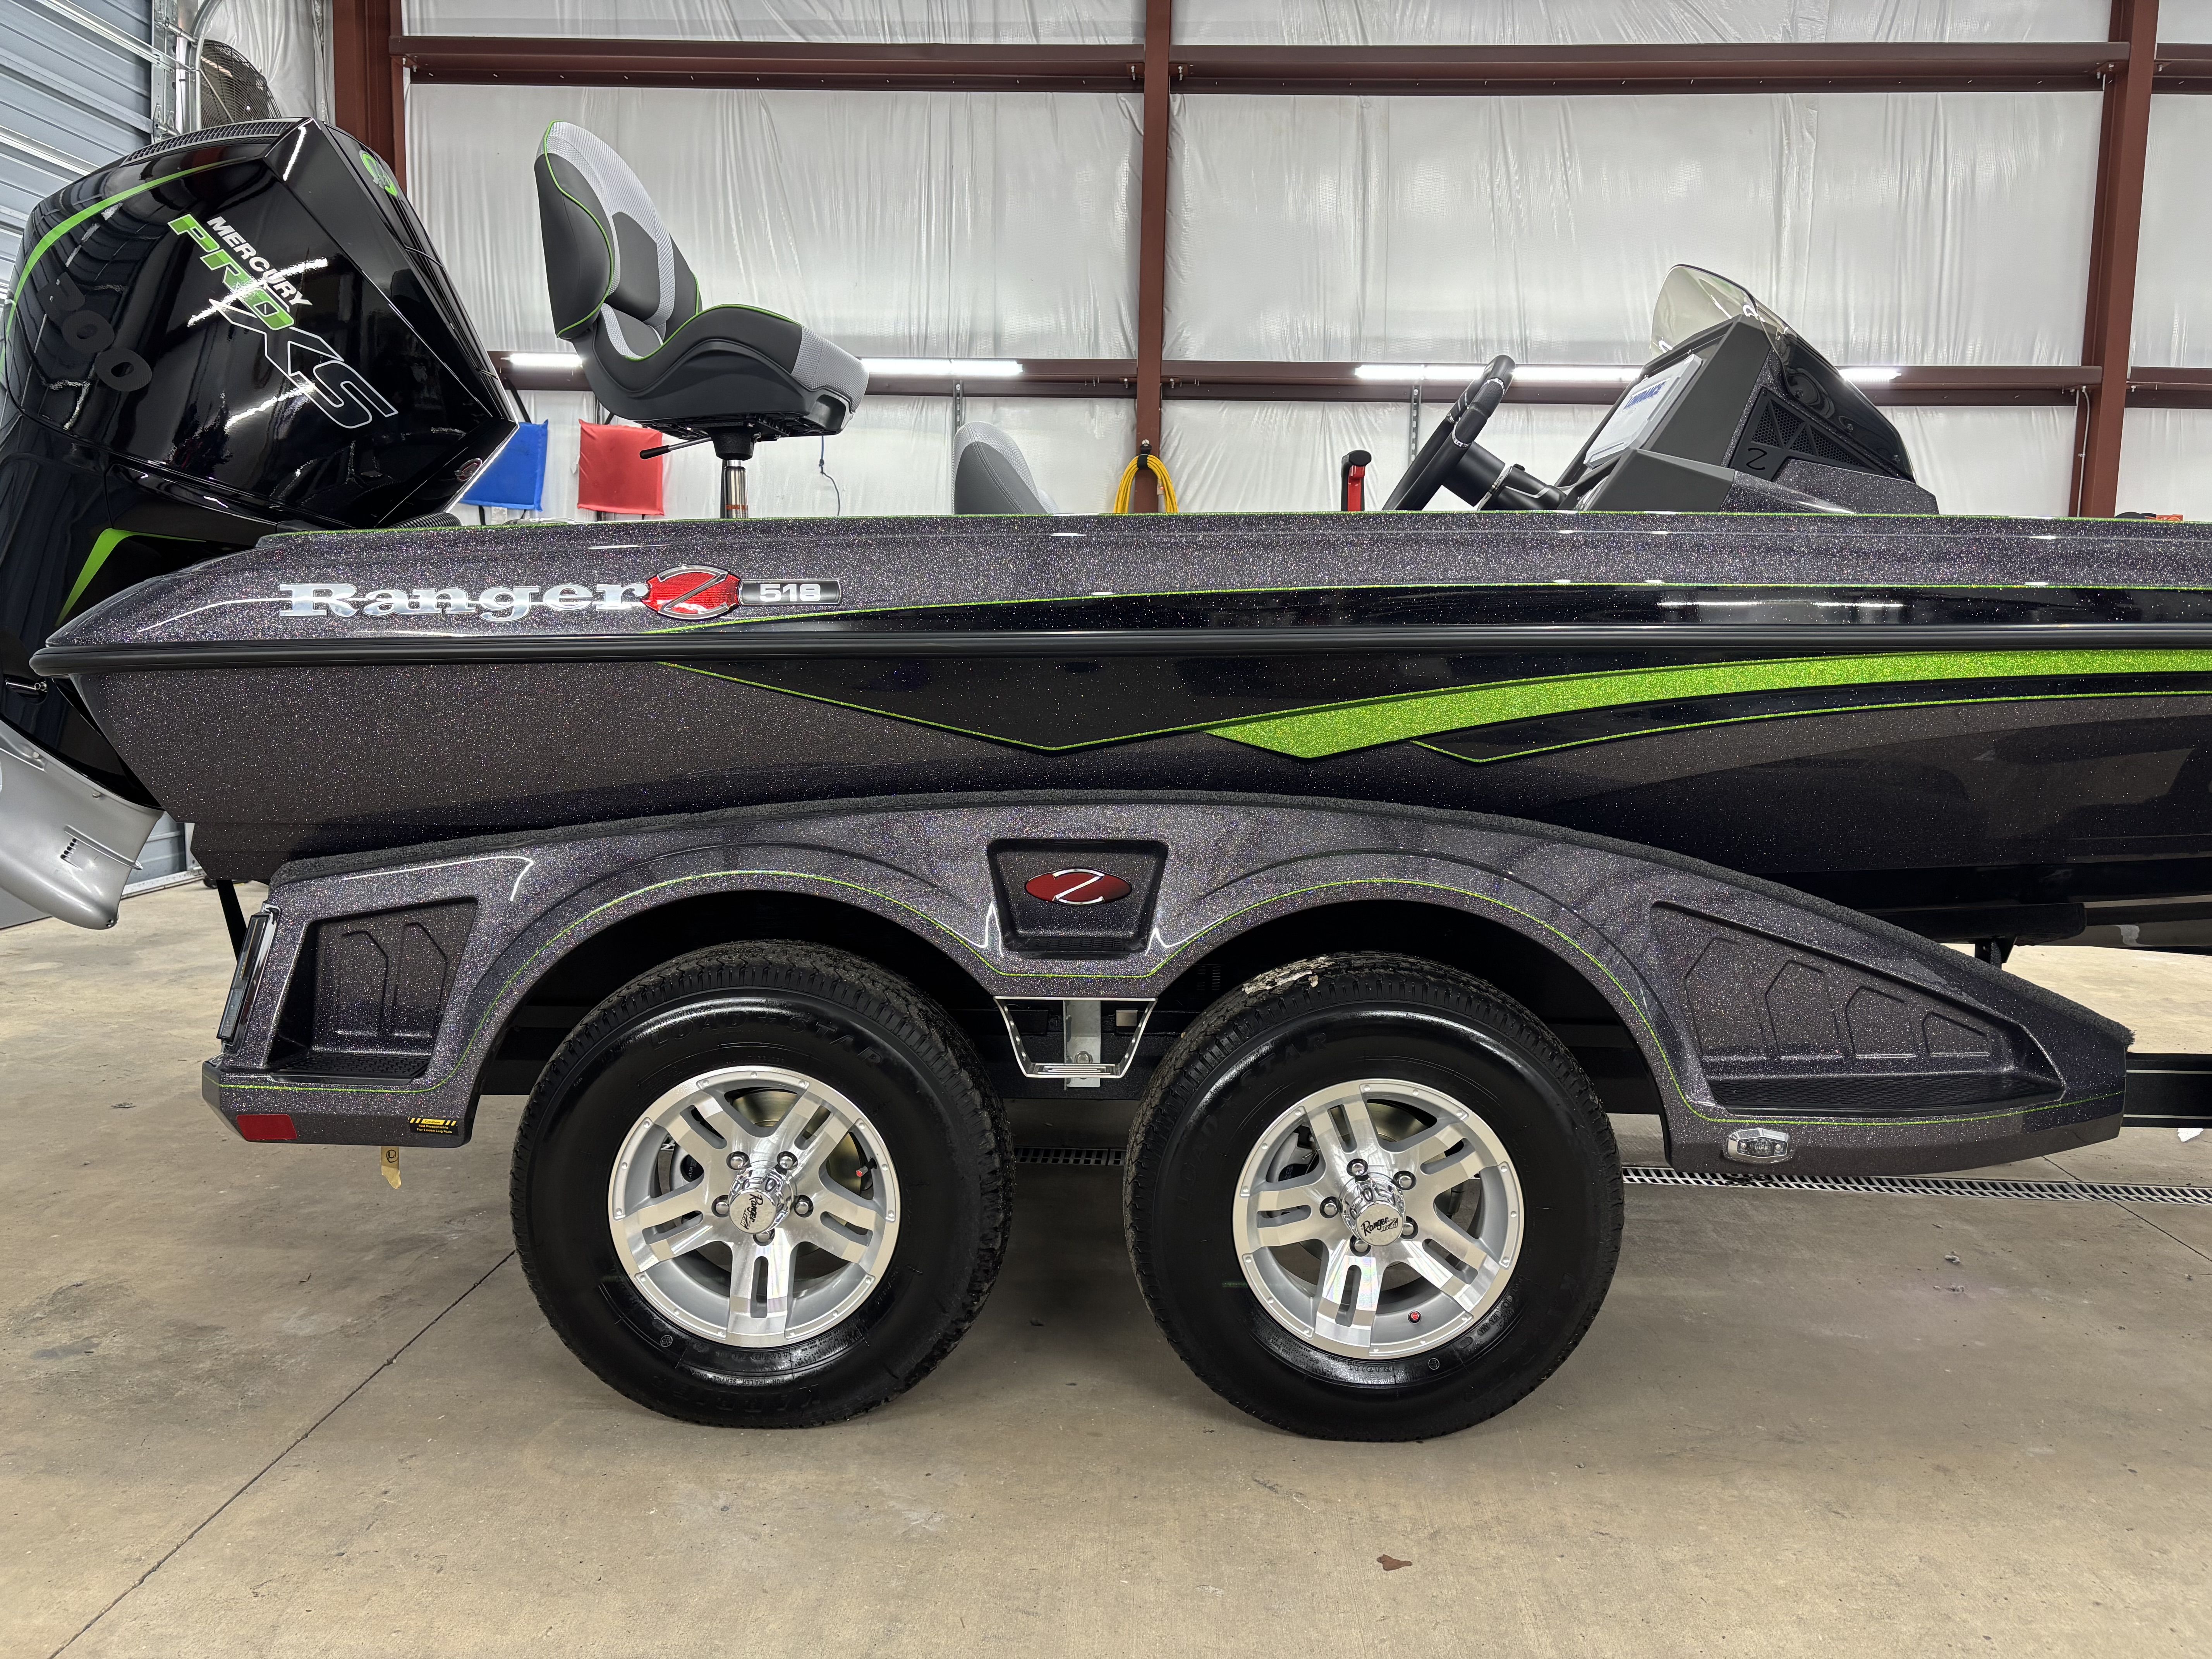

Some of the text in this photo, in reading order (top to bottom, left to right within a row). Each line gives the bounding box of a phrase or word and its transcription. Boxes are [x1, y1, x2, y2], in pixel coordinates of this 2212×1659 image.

[167, 213, 294, 331] PRO
[206, 216, 313, 306] MERCURY
[278, 581, 649, 622] Ranger
[759, 583, 821, 603] 518
[749, 1194, 763, 1223] Ranger
[1360, 1217, 1389, 1237] Ranger
